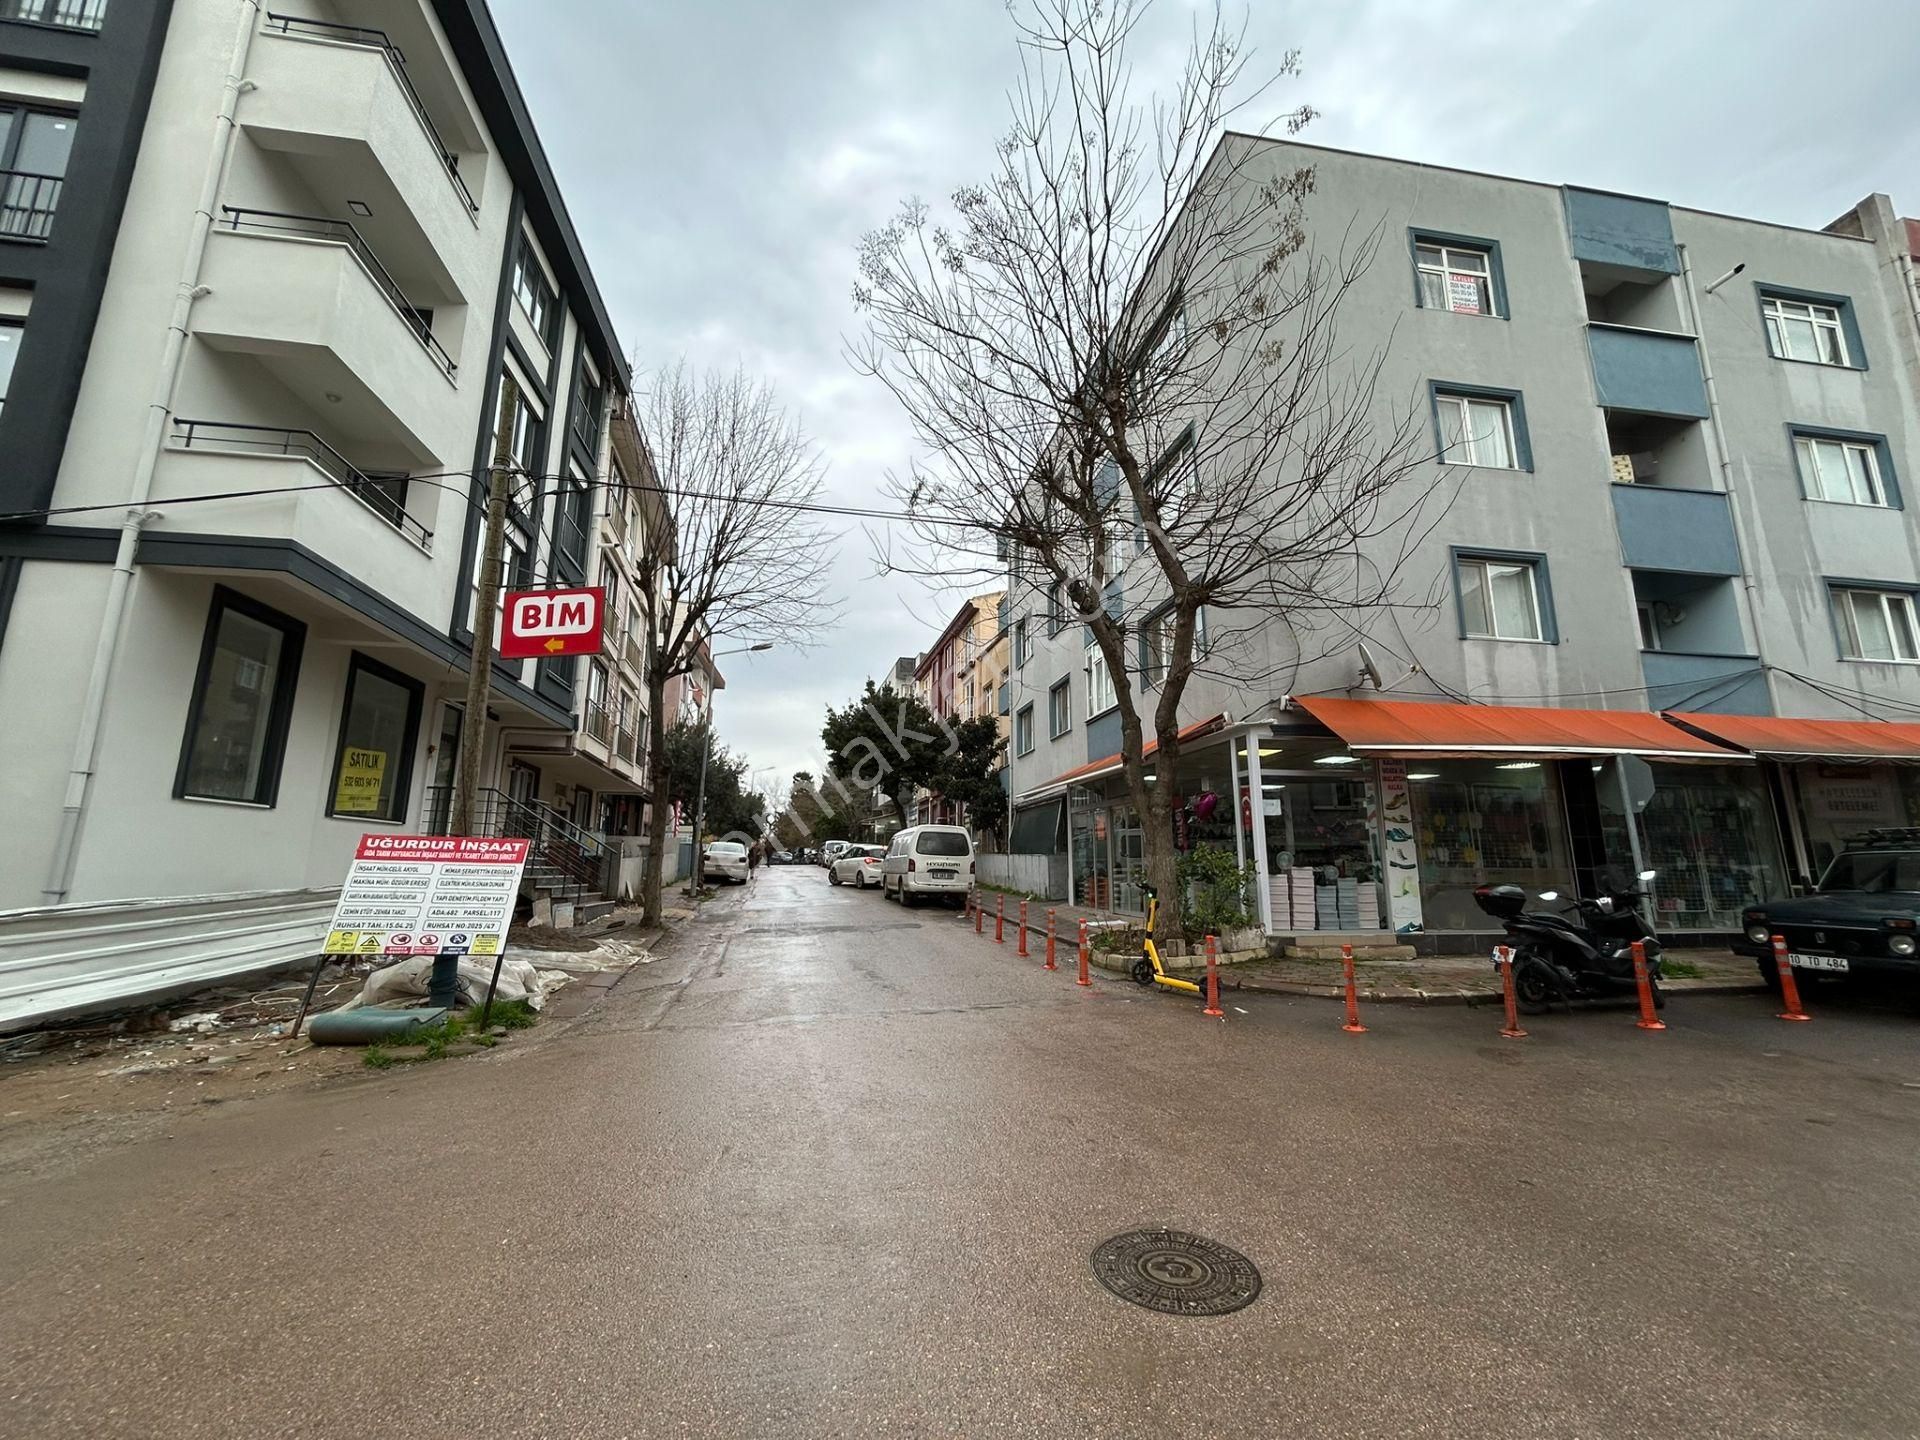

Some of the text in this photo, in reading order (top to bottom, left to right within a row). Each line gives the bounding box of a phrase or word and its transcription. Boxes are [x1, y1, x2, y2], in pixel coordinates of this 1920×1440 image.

[350, 752, 380, 768] SATILIK
[366, 838, 524, 852] UĞURDUR İNŞAAT
[1790, 954, 1800, 964] 10
[1826, 958, 1846, 969] 484
